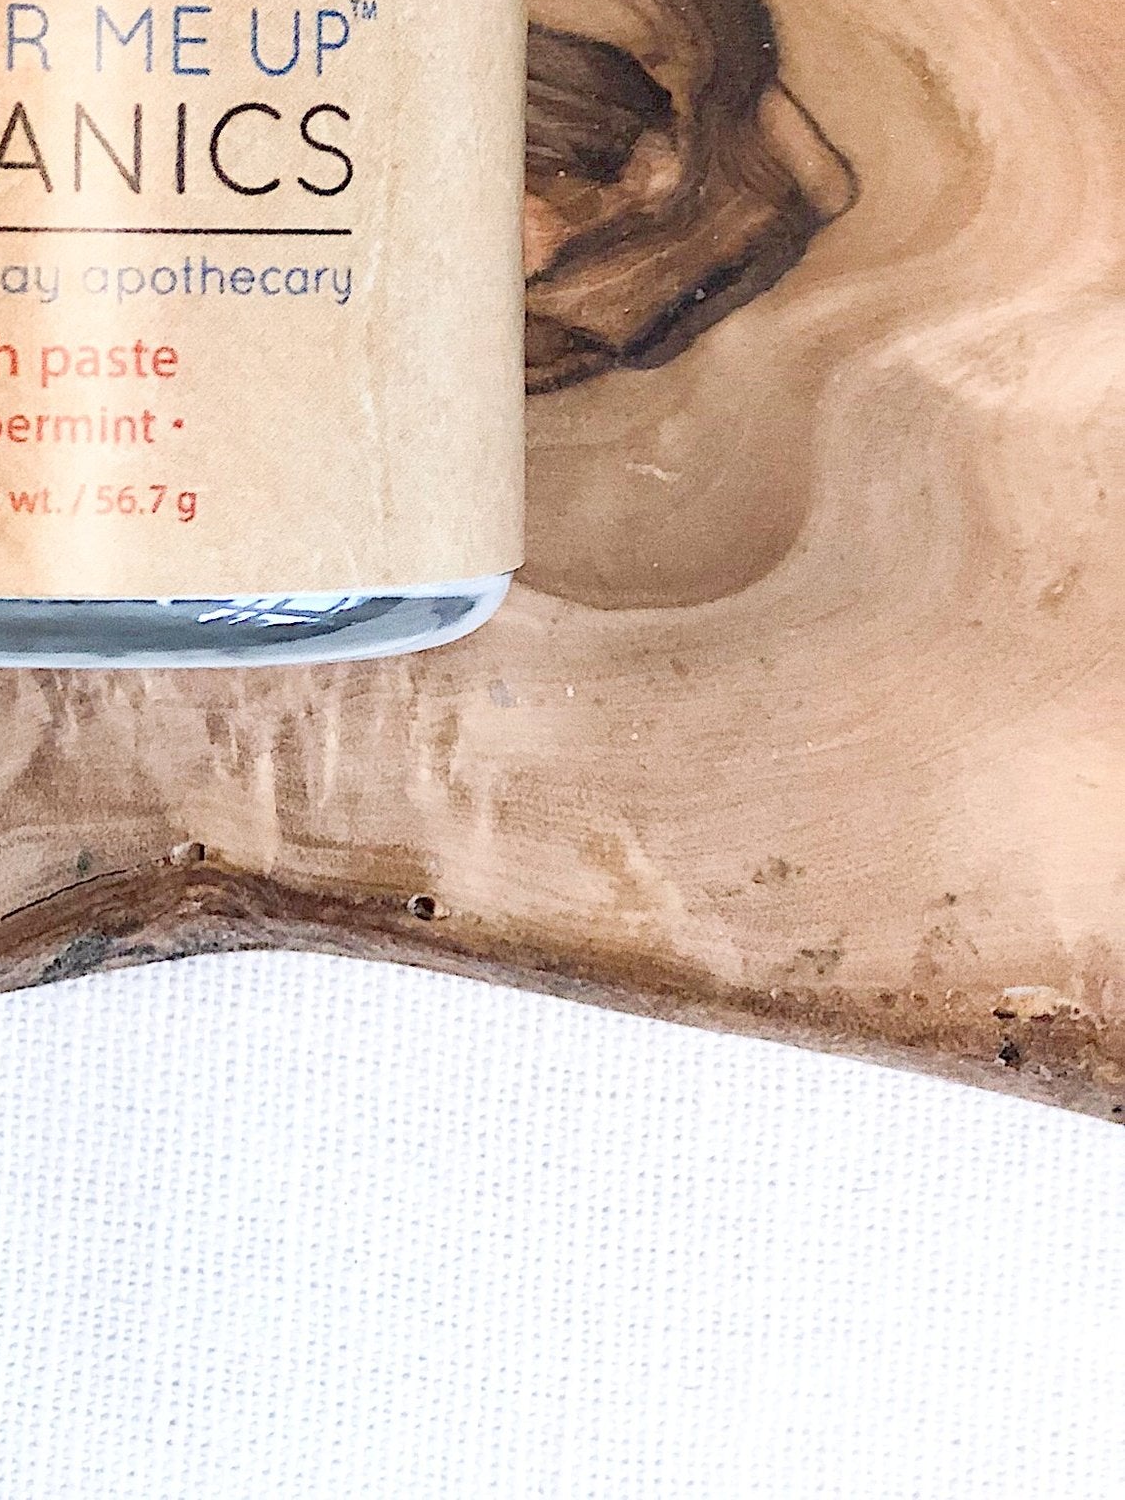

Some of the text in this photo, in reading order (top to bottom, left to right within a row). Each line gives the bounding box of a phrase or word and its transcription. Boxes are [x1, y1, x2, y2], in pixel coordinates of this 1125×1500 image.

[95, 6, 212, 75] ME
[83, 256, 353, 304] apothecary
[40, 338, 179, 388] paste
[8, 485, 63, 515] wt.
[96, 485, 168, 516] 56.7
[177, 490, 198, 522] g
